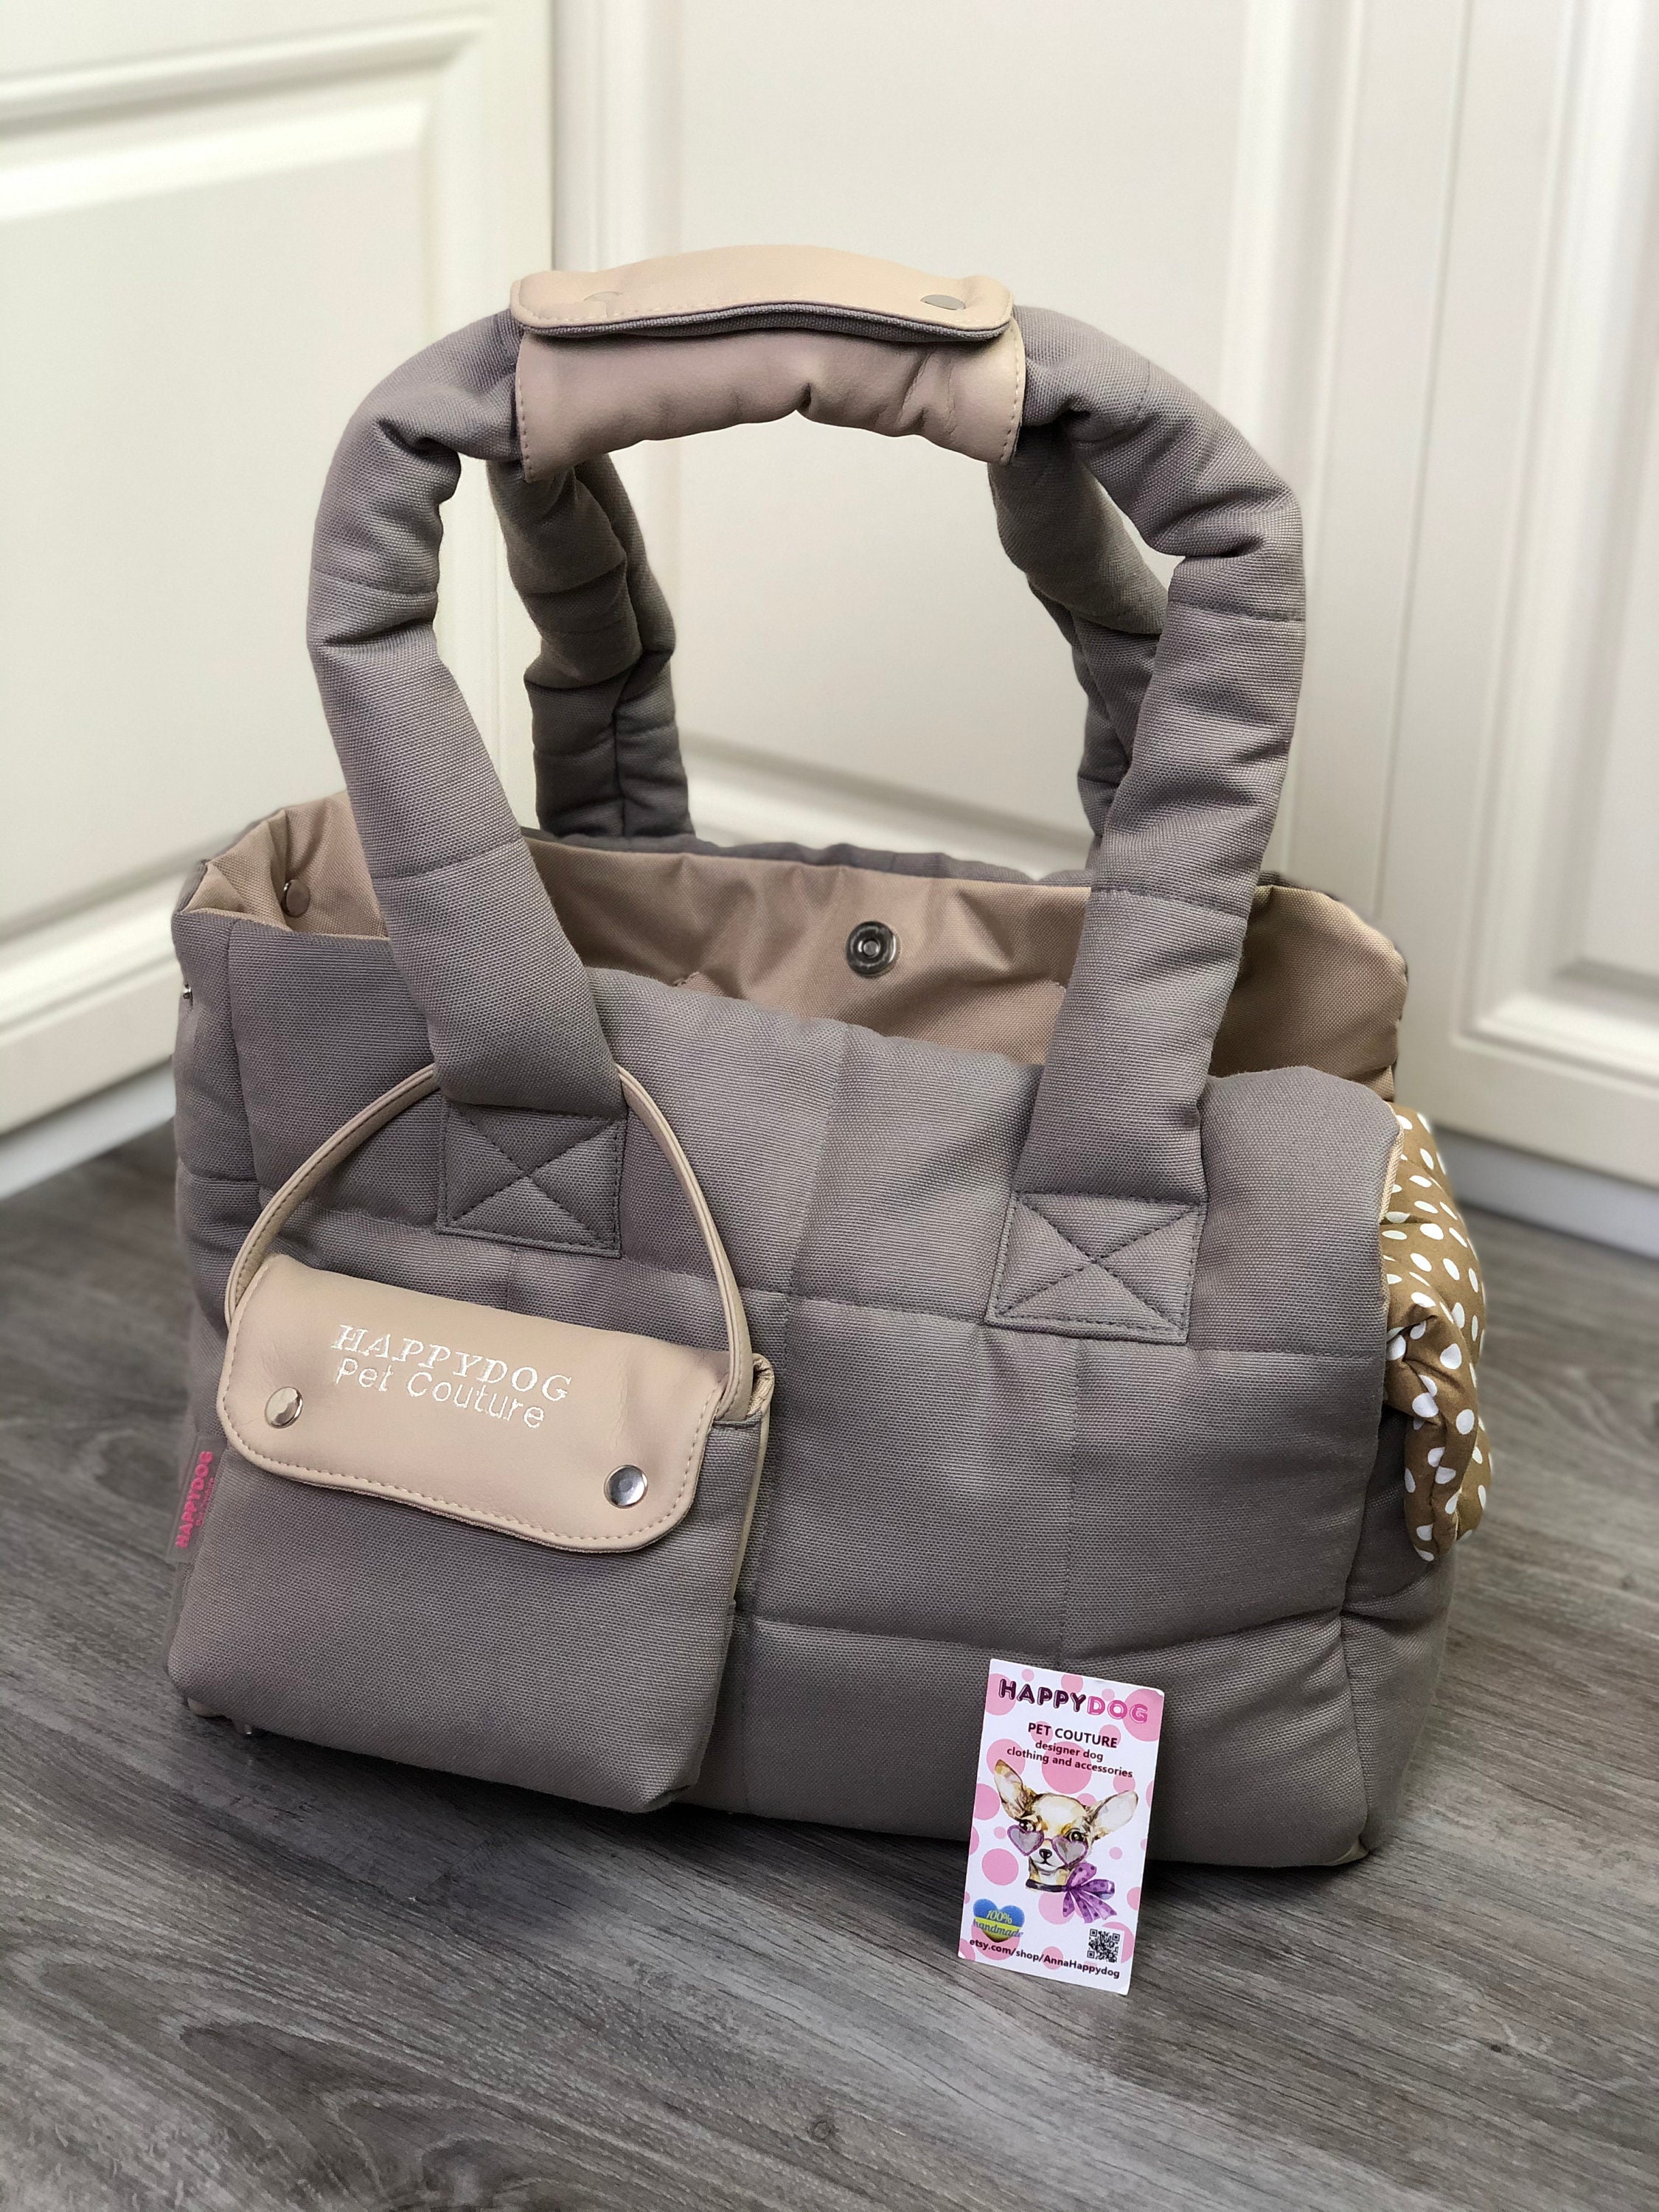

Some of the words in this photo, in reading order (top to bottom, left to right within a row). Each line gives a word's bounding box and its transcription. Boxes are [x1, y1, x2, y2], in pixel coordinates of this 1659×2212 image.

[331, 1324, 572, 1402] HAPPYDOG
[406, 1371, 545, 1428] Couture
[175, 1450, 213, 1548] HAPPYDOG
[998, 1678, 1149, 1724] HAPPYDOG
[1028, 1722, 1052, 1736] PET
[1054, 1728, 1119, 1748] COUTURE
[1034, 1740, 1080, 1757] designer
[1082, 1750, 1104, 1762] dog
[1006, 1747, 1050, 1764] clothing
[1052, 1754, 1072, 1767] and
[1074, 1761, 1134, 1778] accessories
[973, 1918, 1024, 1938] handmade
[986, 1909, 1013, 1924] 100%
[969, 1938, 1121, 1979] etsy.com/shop/AnnaHappydog
